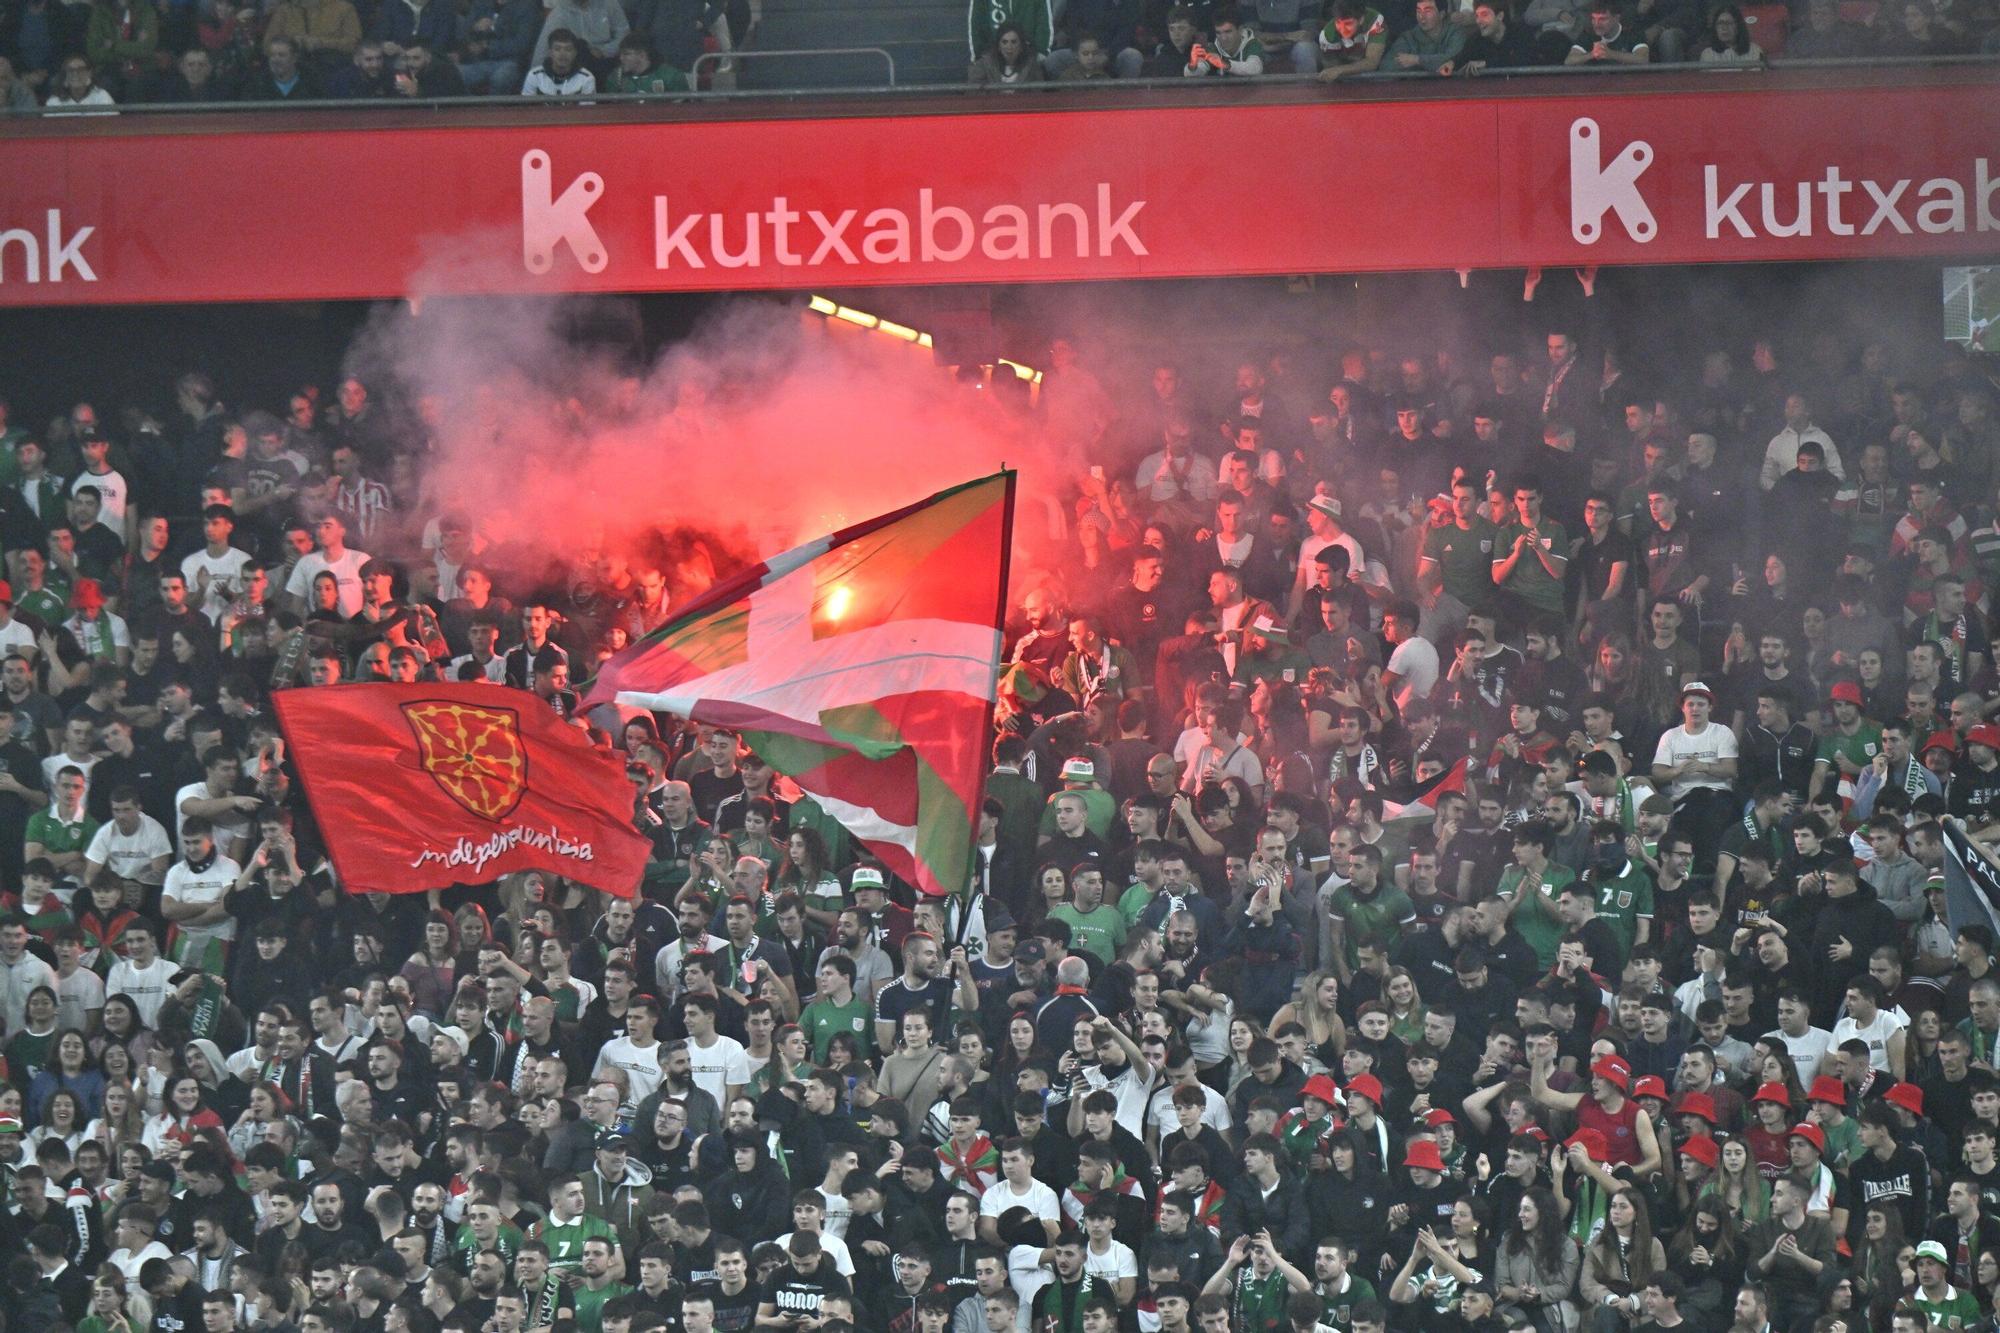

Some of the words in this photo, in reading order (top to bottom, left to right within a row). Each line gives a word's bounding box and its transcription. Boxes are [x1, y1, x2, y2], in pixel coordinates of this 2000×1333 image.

[654, 182, 1149, 270] kutxabank
[0, 208, 98, 284] nk
[411, 824, 595, 875] independentzia
[1602, 887, 1613, 905] 7
[559, 1241, 571, 1257] 7
[1328, 1308, 1337, 1325] 7
[1931, 1311, 1942, 1326] 7
